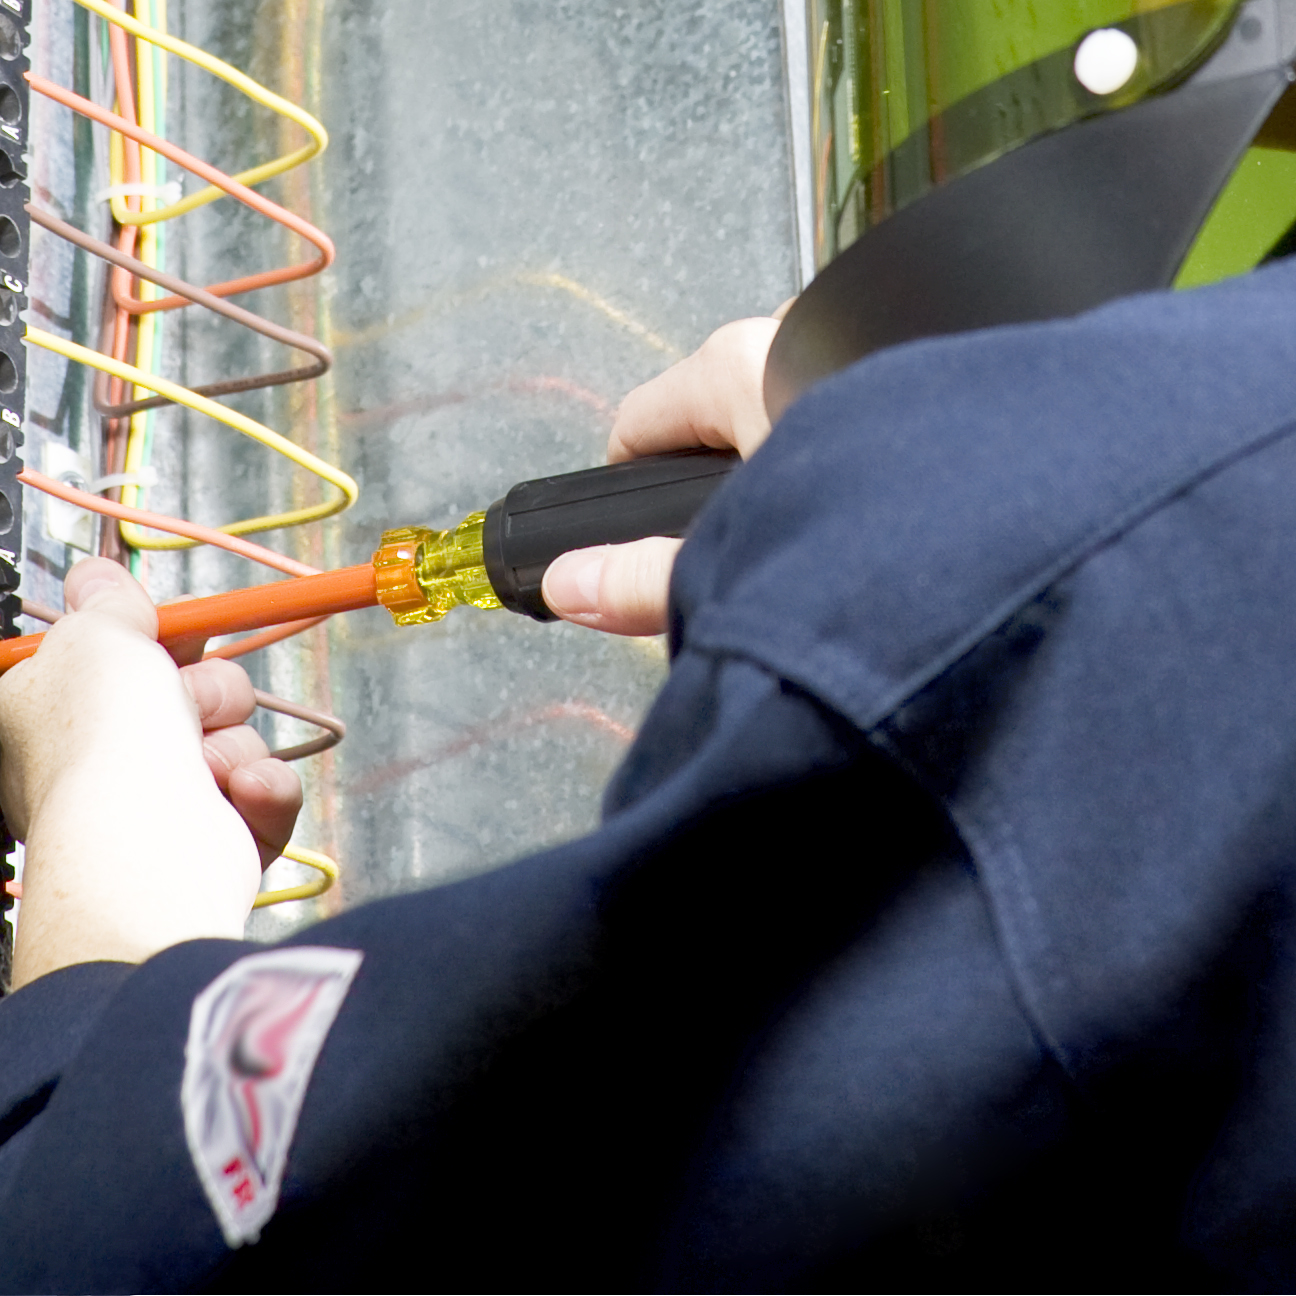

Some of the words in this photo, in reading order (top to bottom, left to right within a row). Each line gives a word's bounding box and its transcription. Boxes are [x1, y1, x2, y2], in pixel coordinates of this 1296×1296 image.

[1, 125, 20, 140] A
[5, 275, 23, 293] C
[2, 408, 20, 428] B
